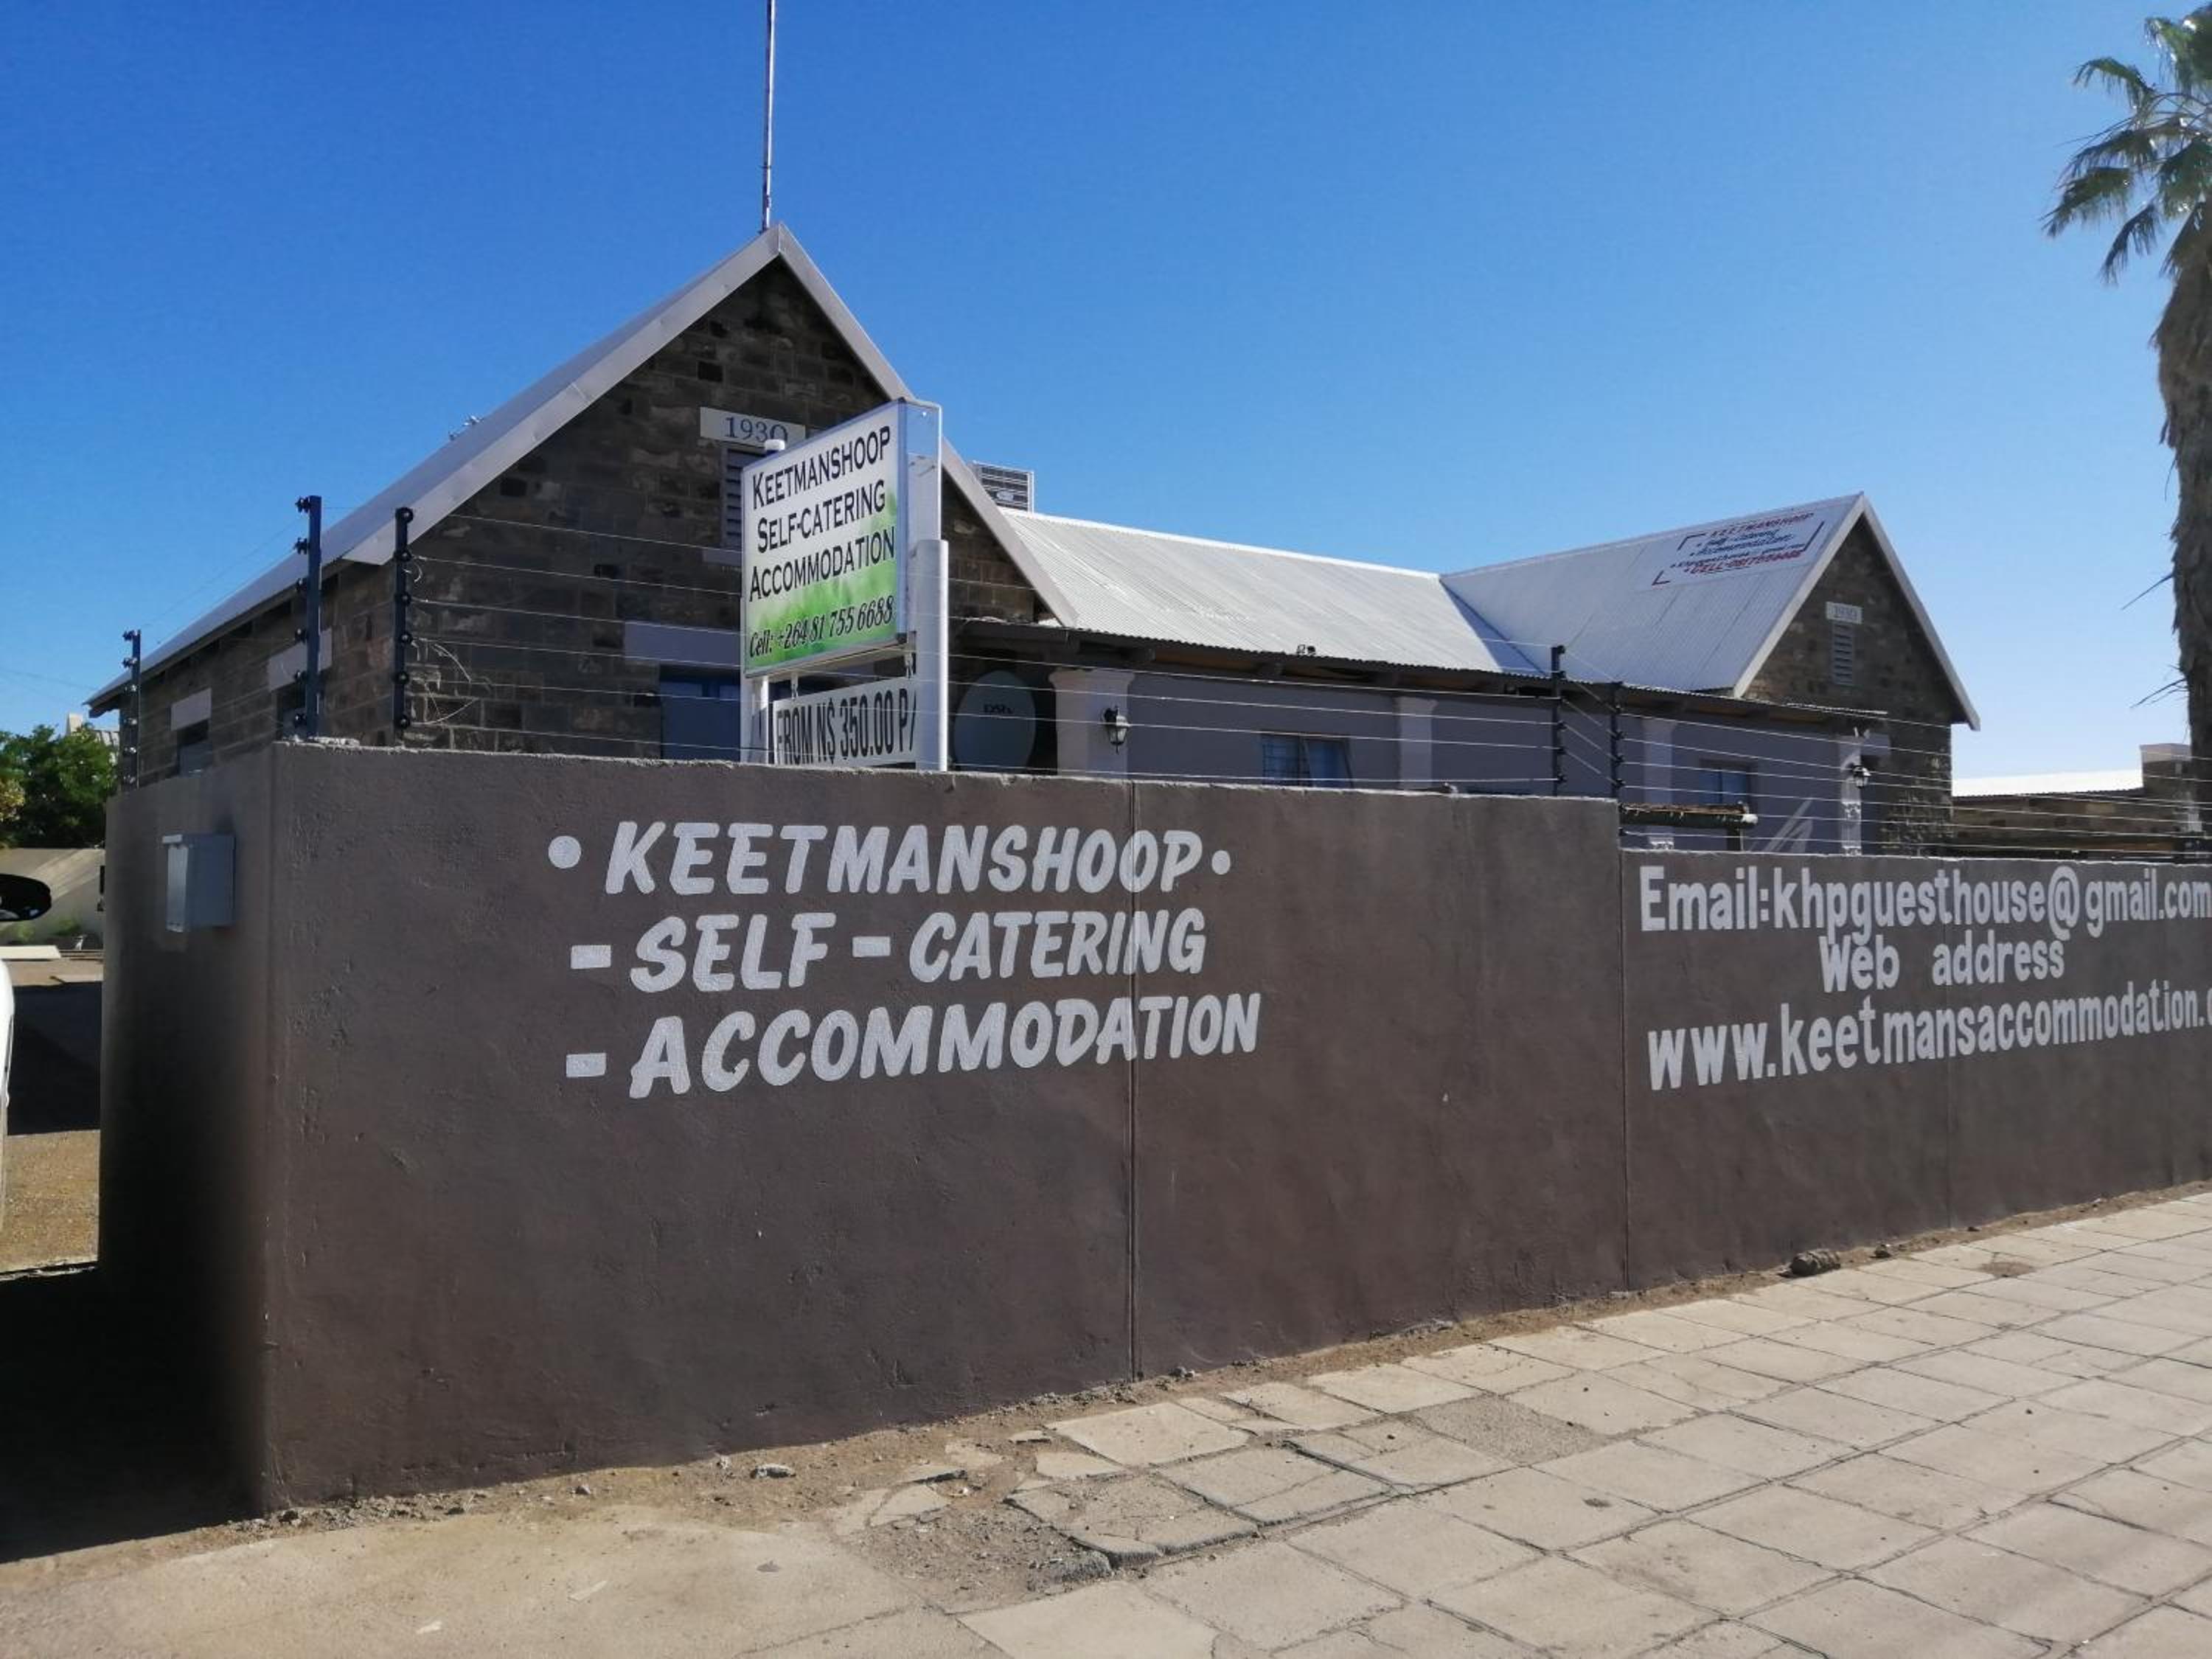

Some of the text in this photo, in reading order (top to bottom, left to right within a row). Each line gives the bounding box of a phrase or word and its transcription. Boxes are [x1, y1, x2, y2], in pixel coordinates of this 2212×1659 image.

[725, 416, 788, 443] 1930
[753, 425, 891, 510] KEETMANSHOOP
[757, 479, 886, 554] SELF-CATERING
[749, 526, 895, 602] ACCOMMODATION
[749, 628, 773, 658] Cell:
[811, 614, 826, 642] 81
[830, 606, 855, 637] 755
[857, 595, 894, 631] 6688
[776, 705, 813, 765] FROM
[817, 697, 835, 765] N$
[840, 689, 894, 758] 350.00
[605, 821, 1203, 894] KEETMANSHOOP
[908, 908, 1207, 983] CATERING
[1819, 930, 2065, 992] Web address
[629, 992, 1262, 1099] ACCOMMODATION
